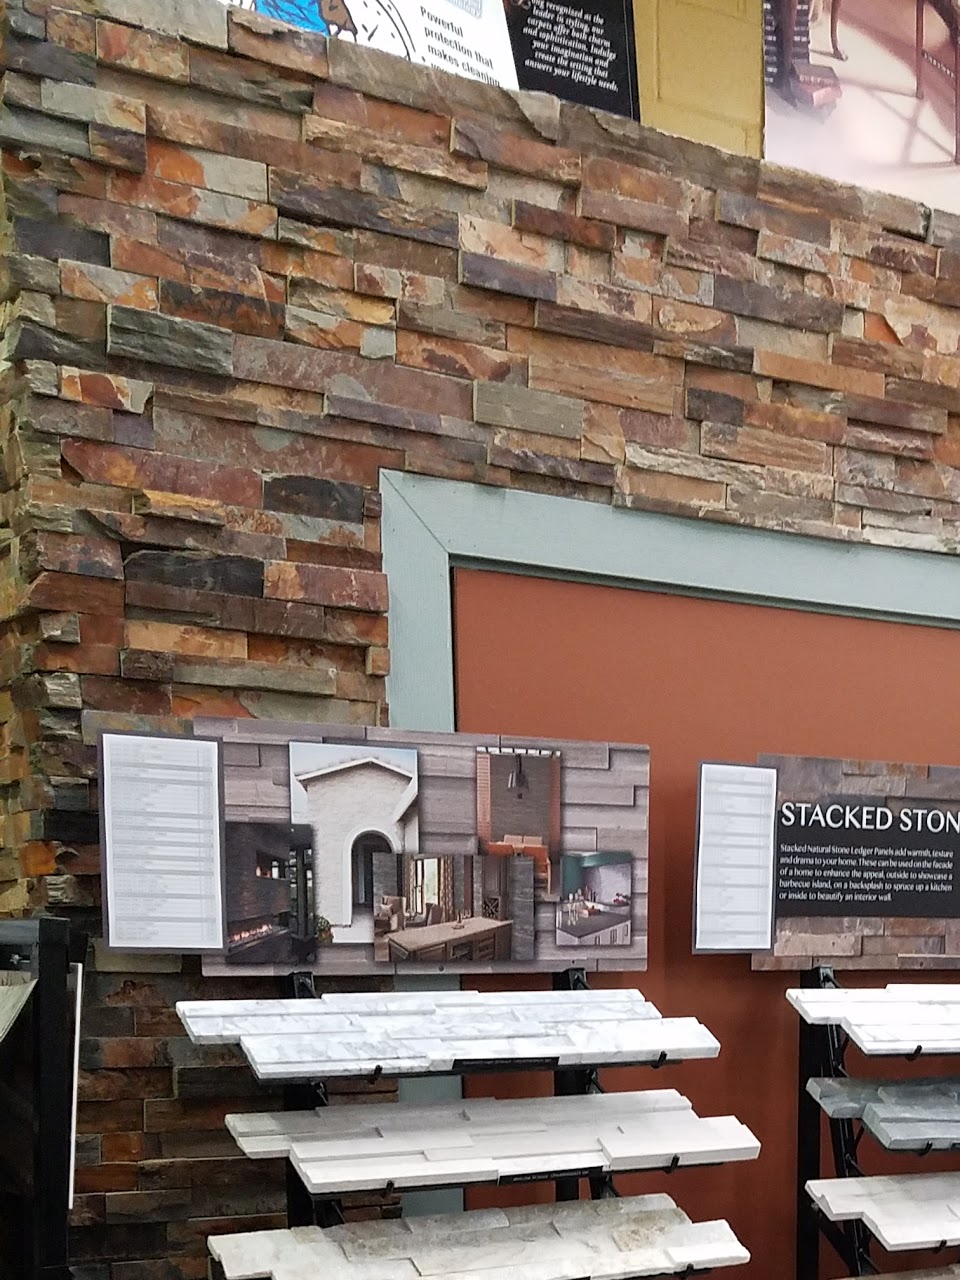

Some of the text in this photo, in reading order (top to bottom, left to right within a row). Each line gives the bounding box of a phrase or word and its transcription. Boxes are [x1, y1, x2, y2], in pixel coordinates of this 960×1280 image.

[420, 6, 463, 37] Powerful
[527, 17, 611, 47] carpets offer both charm
[533, 6, 555, 20] leader
[556, 15, 564, 23] in
[592, 26, 604, 35] our
[593, 14, 604, 25] the
[424, 27, 493, 69] protection that
[427, 45, 459, 67] makes
[523, 27, 538, 37] and
[590, 44, 617, 61] Indulge
[532, 40, 609, 68] your imagination and
[525, 59, 552, 73] answers
[553, 67, 570, 76] your
[571, 70, 597, 86] lifestyle
[534, 51, 608, 78] create the setting that
[781, 801, 893, 830] STACKED
[780, 856, 793, 864] and
[793, 856, 814, 865] drama
[815, 857, 822, 865] to
[822, 858, 837, 867] your
[859, 858, 877, 867] These
[877, 859, 889, 867] can
[890, 859, 897, 867] be
[898, 860, 913, 868] used
[921, 860, 932, 869] the
[781, 843, 806, 854] Stacked
[808, 844, 831, 854] Natural
[832, 845, 850, 855] Stone
[851, 846, 873, 857] Ledger
[874, 847, 894, 856] Panels
[895, 848, 907, 856] add
[932, 850, 953, 858] texture
[779, 879, 811, 888] barbecue
[849, 881, 884, 891] backsplash
[885, 882, 892, 890] to
[893, 883, 914, 892] spruce
[915, 884, 924, 892] up
[930, 882, 953, 892] kitchen
[780, 867, 788, 876] of
[794, 868, 813, 877] home
[815, 868, 822, 877] to
[823, 868, 850, 877] enhance
[851, 869, 861, 878] the
[886, 870, 909, 879] outside
[910, 871, 917, 879] to
[918, 871, 948, 880] showcase
[788, 891, 807, 899] inside
[808, 892, 816, 900] to
[817, 891, 843, 902] beautify
[854, 892, 877, 900] interior
